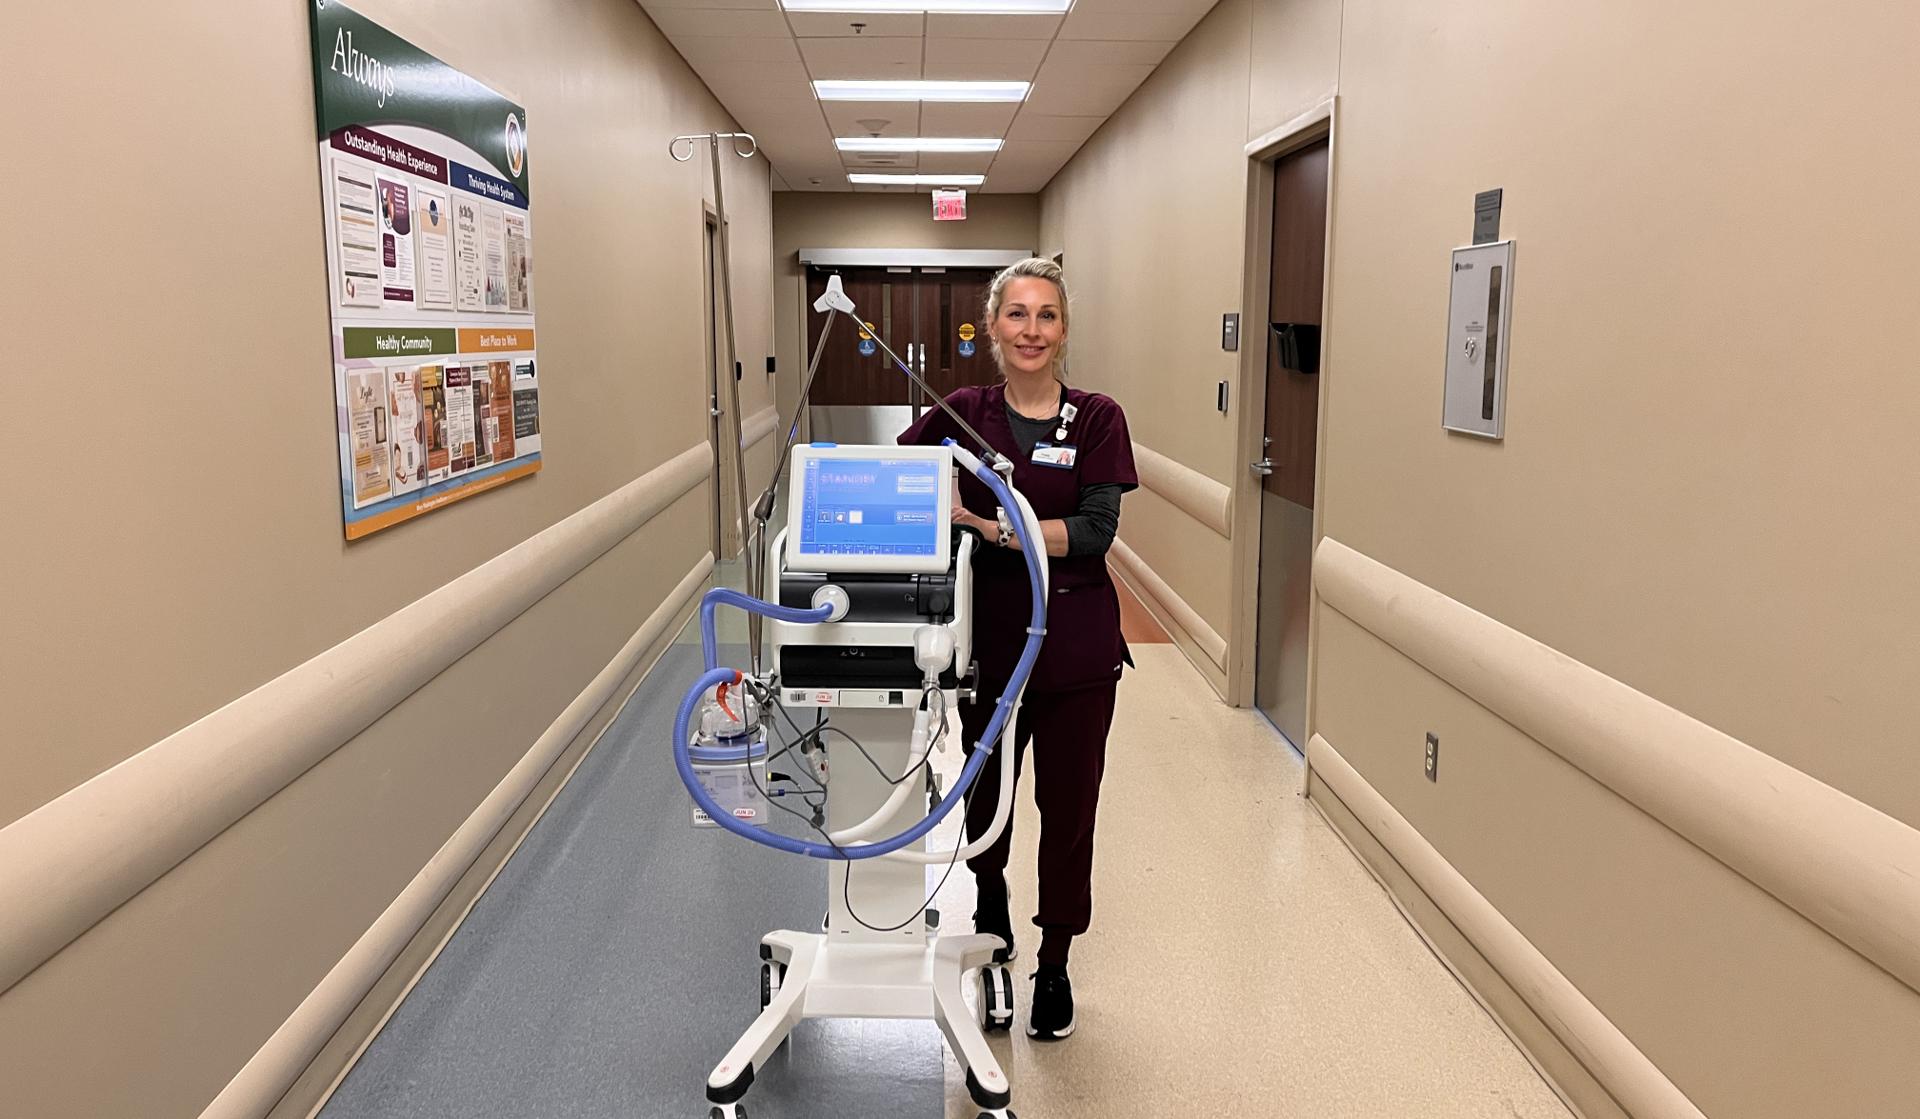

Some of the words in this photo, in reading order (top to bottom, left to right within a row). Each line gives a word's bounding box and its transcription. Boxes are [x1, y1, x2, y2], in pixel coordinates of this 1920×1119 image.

[331, 27, 394, 108] Always
[344, 130, 386, 162] Outstanding
[386, 145, 407, 164] Health
[407, 151, 438, 175] Experience
[468, 173, 487, 194] Thriving
[487, 180, 500, 196] Health
[500, 186, 515, 201] System
[376, 335, 400, 353] Healthy
[401, 336, 432, 351] Community
[480, 335, 490, 347] Best
[490, 335, 501, 347] Place
[501, 336, 507, 346] to
[507, 335, 517, 346] Work
